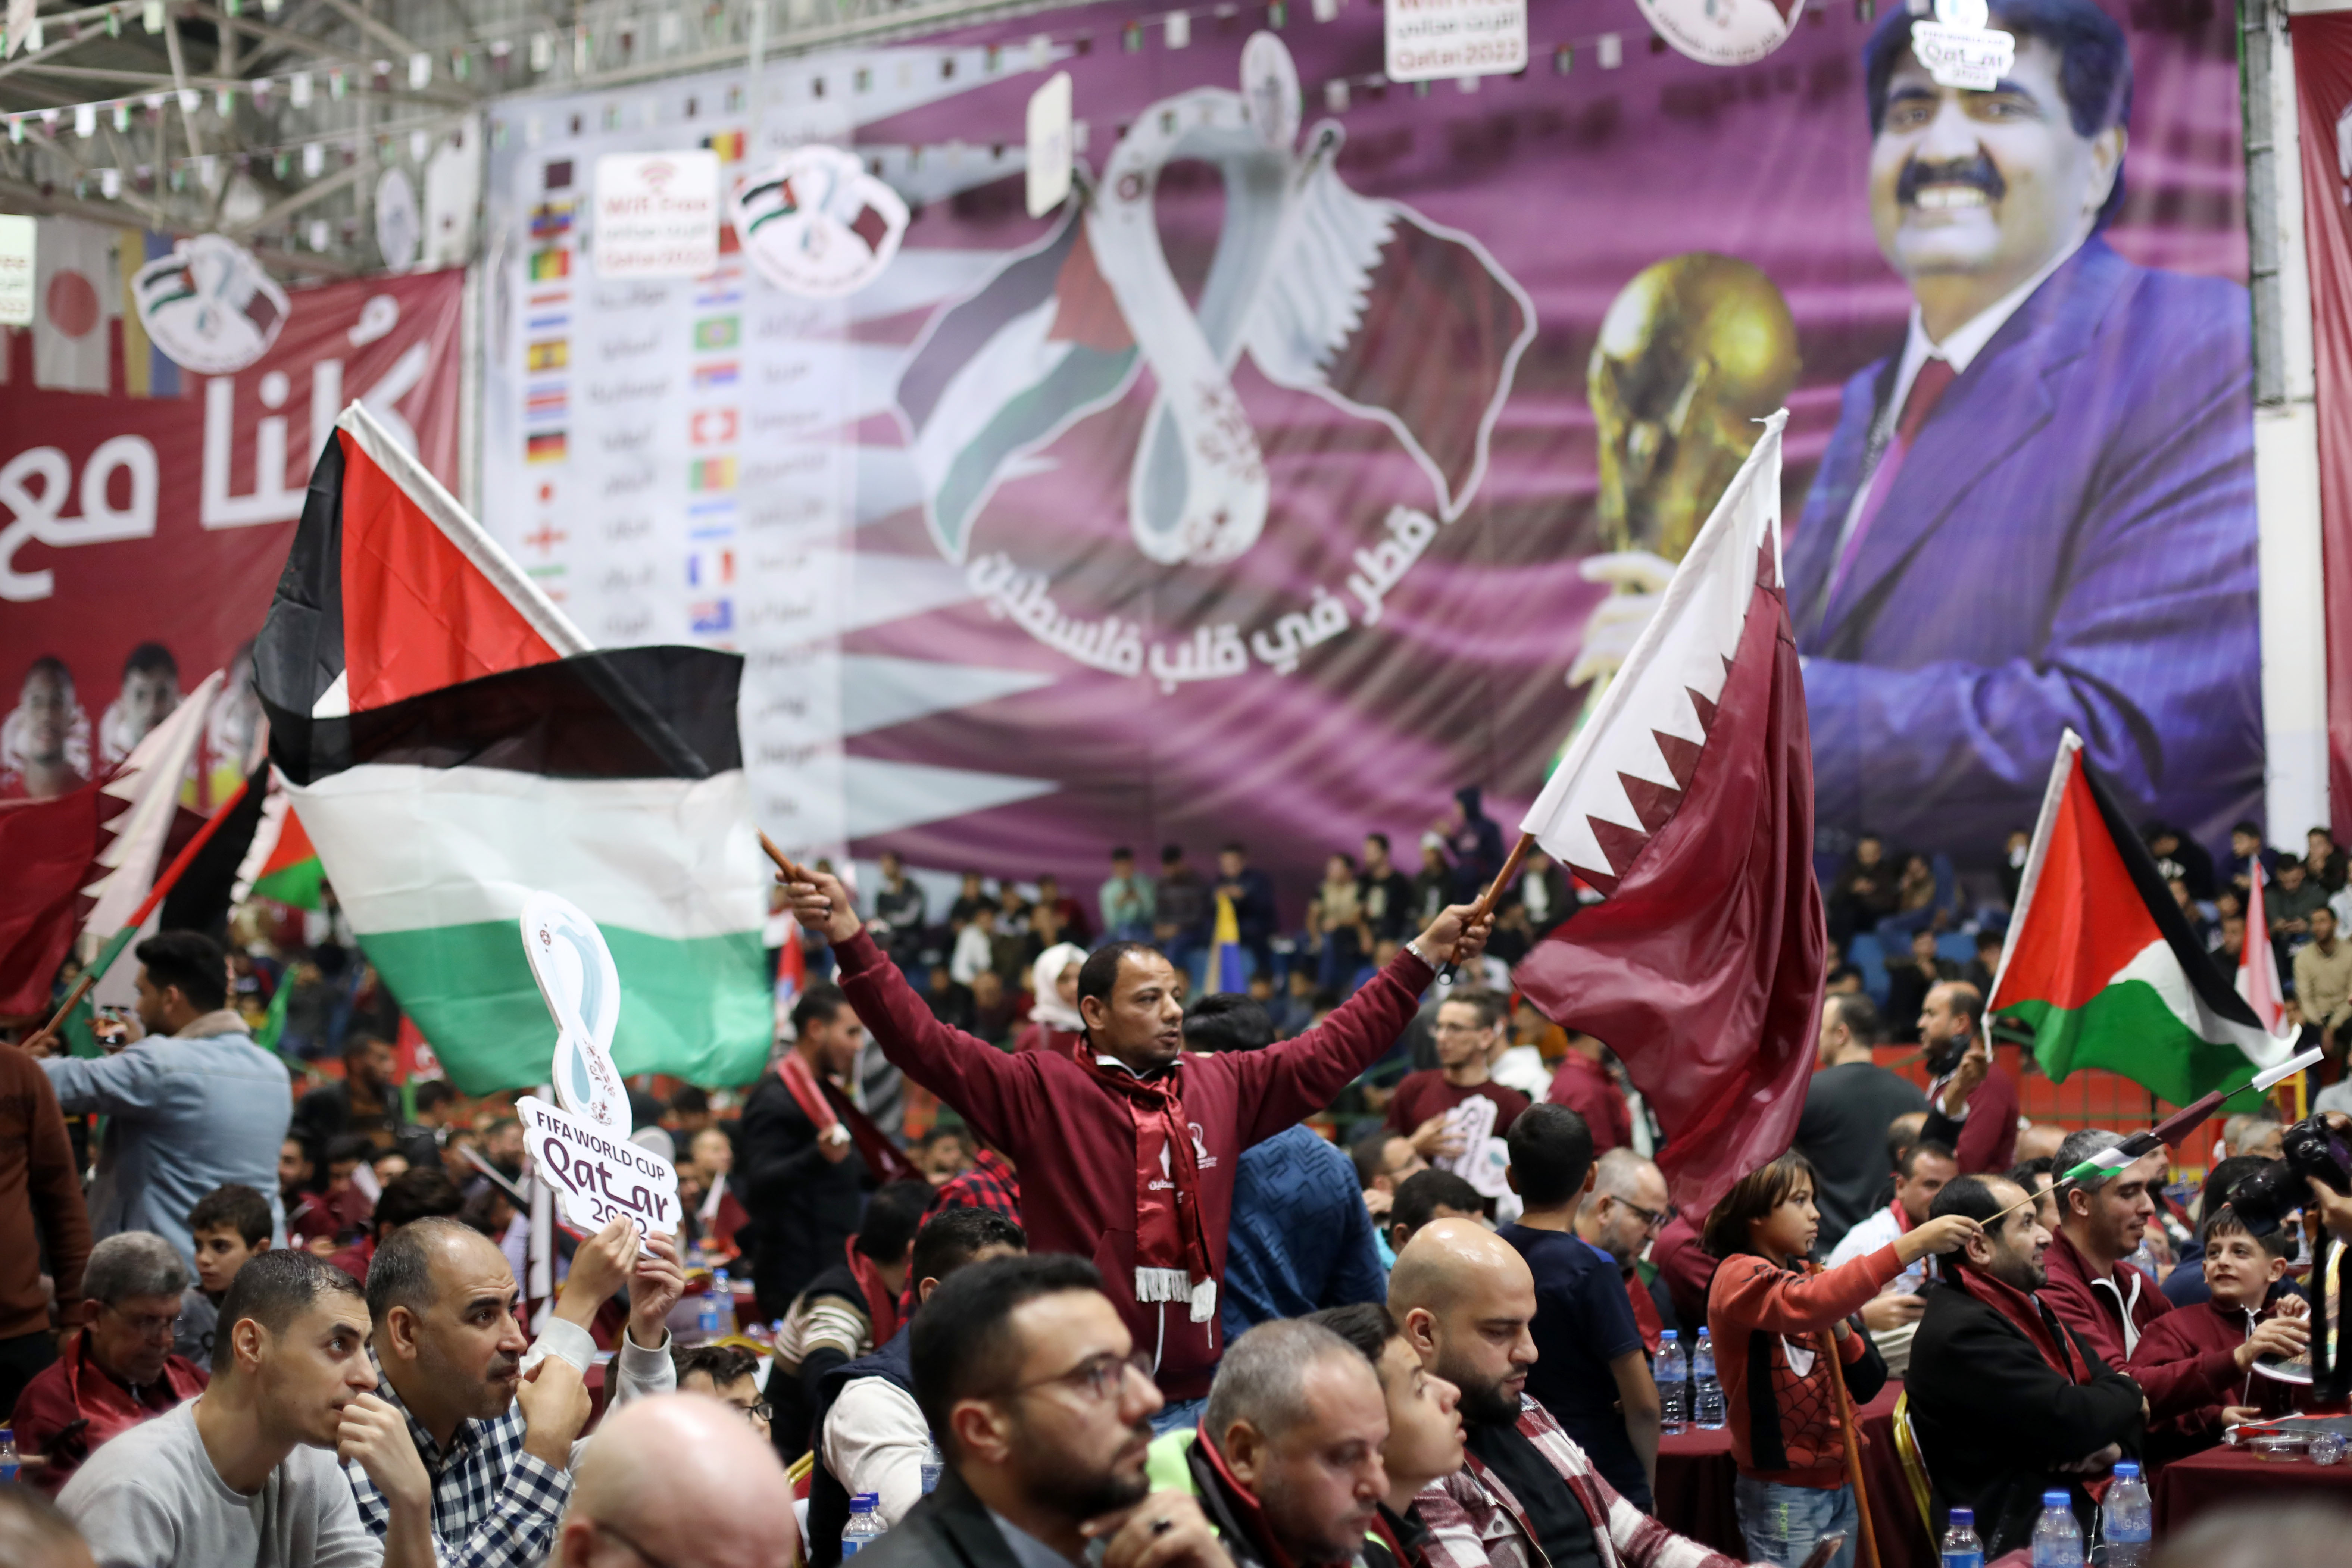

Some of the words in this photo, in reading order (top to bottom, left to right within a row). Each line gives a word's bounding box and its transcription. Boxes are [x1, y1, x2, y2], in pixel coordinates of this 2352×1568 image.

[1347, 505, 1438, 627] قطر
[966, 552, 1144, 679] فلسطين
[1250, 586, 1351, 677] في
[1149, 624, 1250, 695] قلب
[536, 1111, 573, 1141] FIFA
[574, 1128, 632, 1166] WORLD
[636, 1157, 665, 1181] CUP
[543, 1137, 669, 1222] Qatar
[1148, 1179, 1175, 1190] سطين
